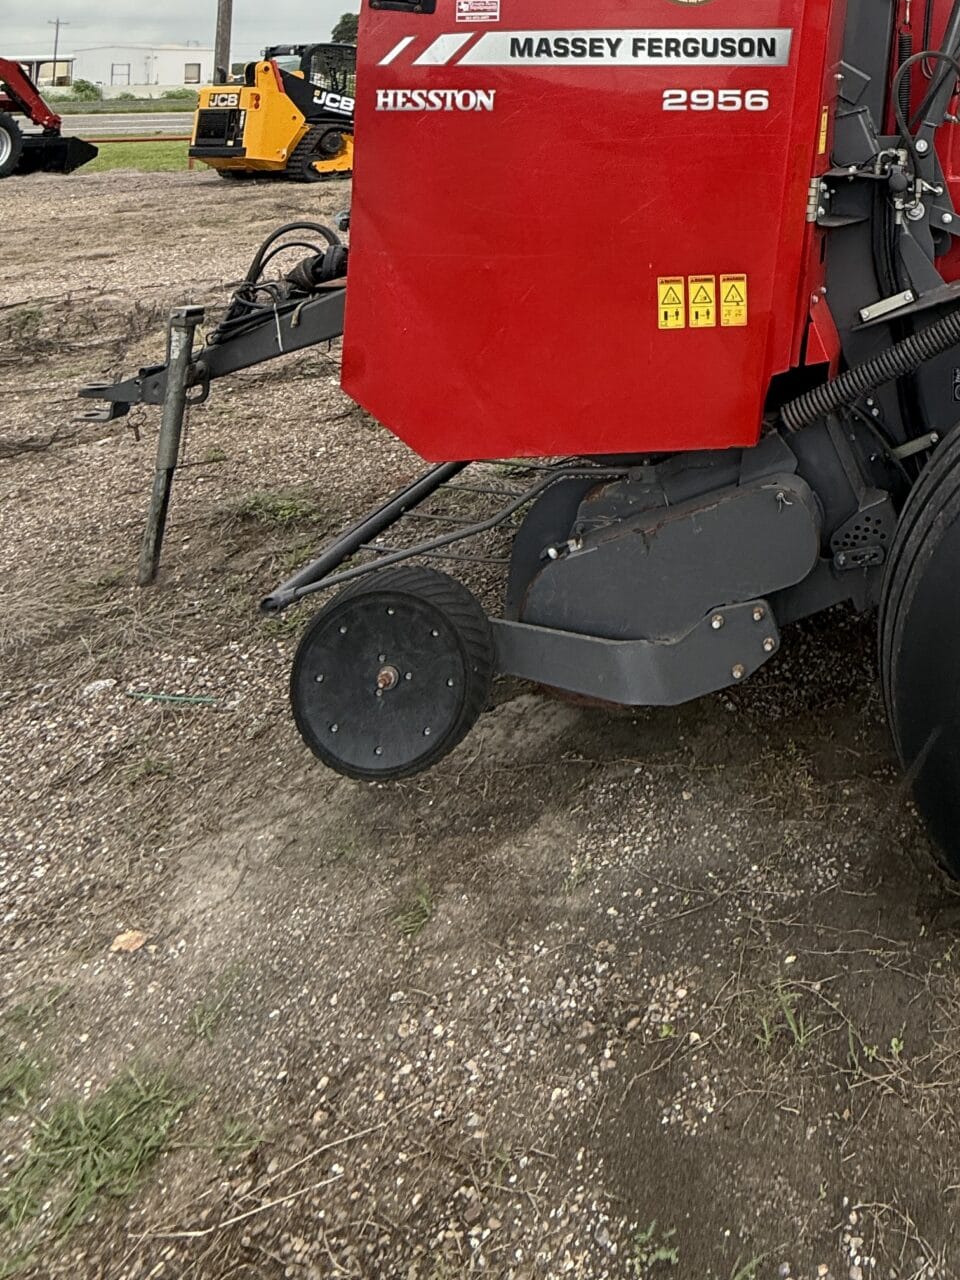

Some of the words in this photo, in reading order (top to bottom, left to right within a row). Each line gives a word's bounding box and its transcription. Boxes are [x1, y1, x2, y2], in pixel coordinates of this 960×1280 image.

[510, 37, 623, 58] MASSEY
[632, 37, 776, 58] FERGUSON
[209, 93, 238, 107] JCB
[313, 89, 356, 112] JCB
[375, 89, 497, 112] HESSTON
[662, 89, 770, 112] 2956
